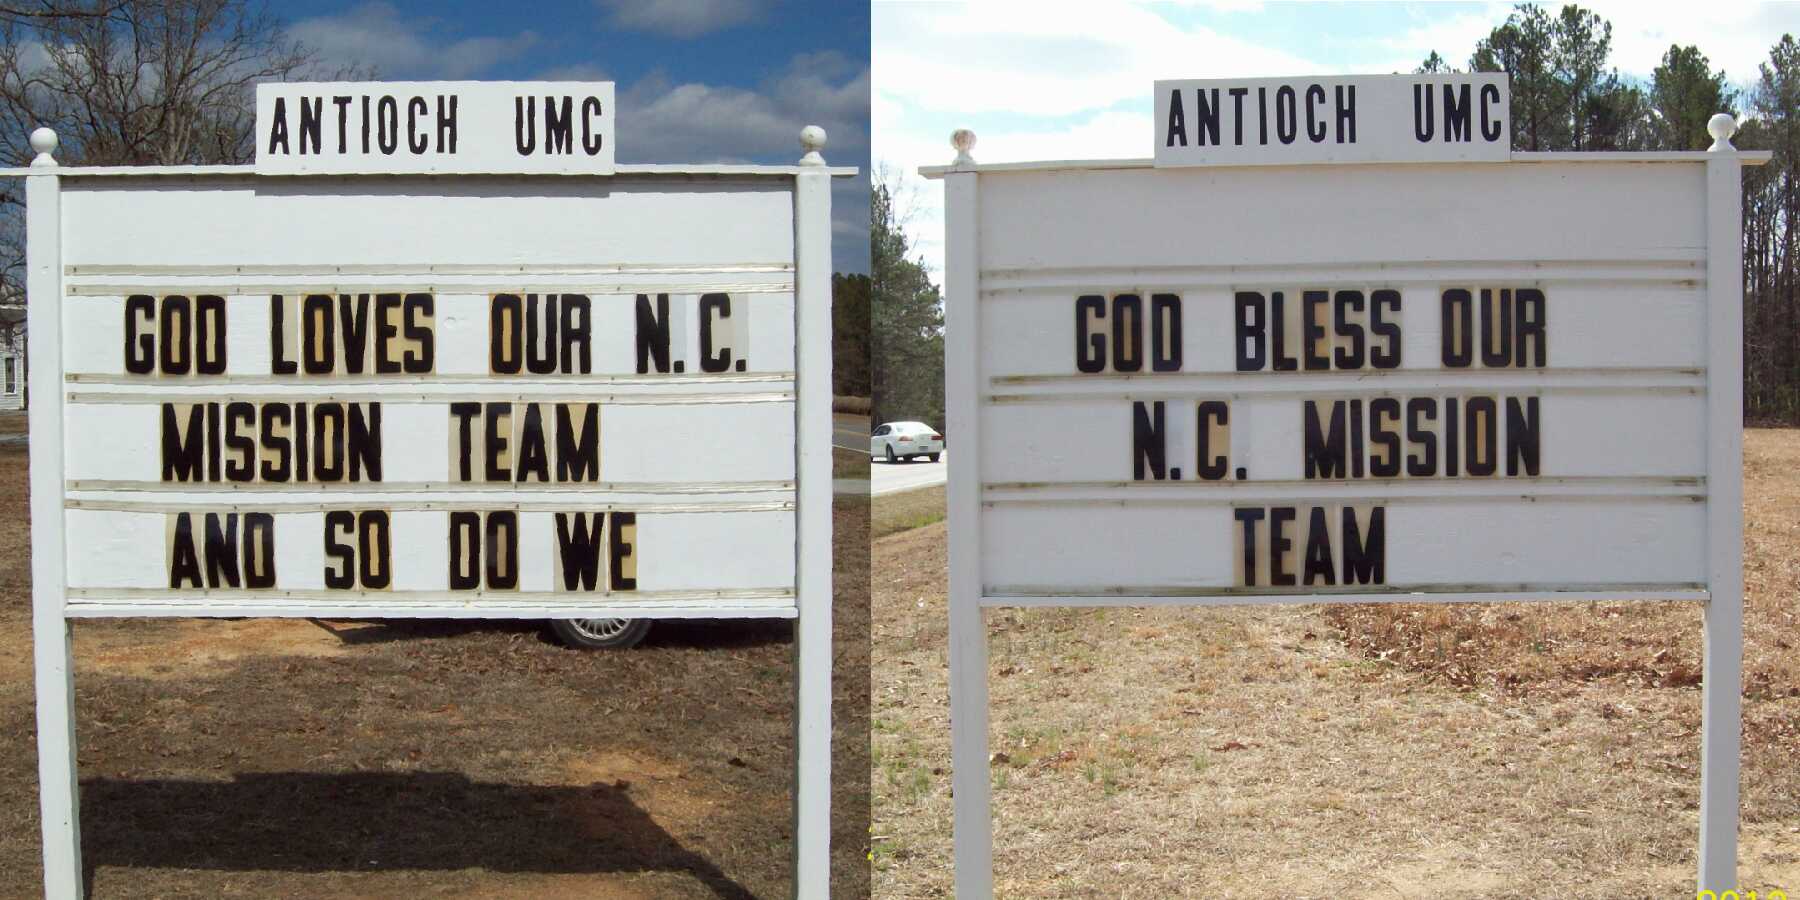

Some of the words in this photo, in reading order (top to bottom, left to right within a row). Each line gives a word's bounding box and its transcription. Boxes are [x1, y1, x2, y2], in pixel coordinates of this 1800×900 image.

[269, 95, 458, 156] ANTIOCH
[515, 95, 602, 156] UMC
[1166, 83, 1356, 147] ANTIOCH
[1413, 83, 1502, 143] UMC
[124, 294, 227, 376] GOD
[271, 292, 434, 376] LOVES
[491, 293, 592, 375] OUR
[1075, 292, 1183, 374] GOD
[1234, 289, 1402, 372] BLESS
[1441, 288, 1547, 369] OUR
[161, 401, 382, 483] MISSION
[450, 402, 599, 483] TEAM
[1304, 396, 1540, 480] MISSION
[170, 511, 276, 590] AND
[324, 509, 391, 590] SO
[449, 510, 518, 591] DO
[555, 511, 637, 592] WE
[1234, 506, 1385, 587] TEAM
